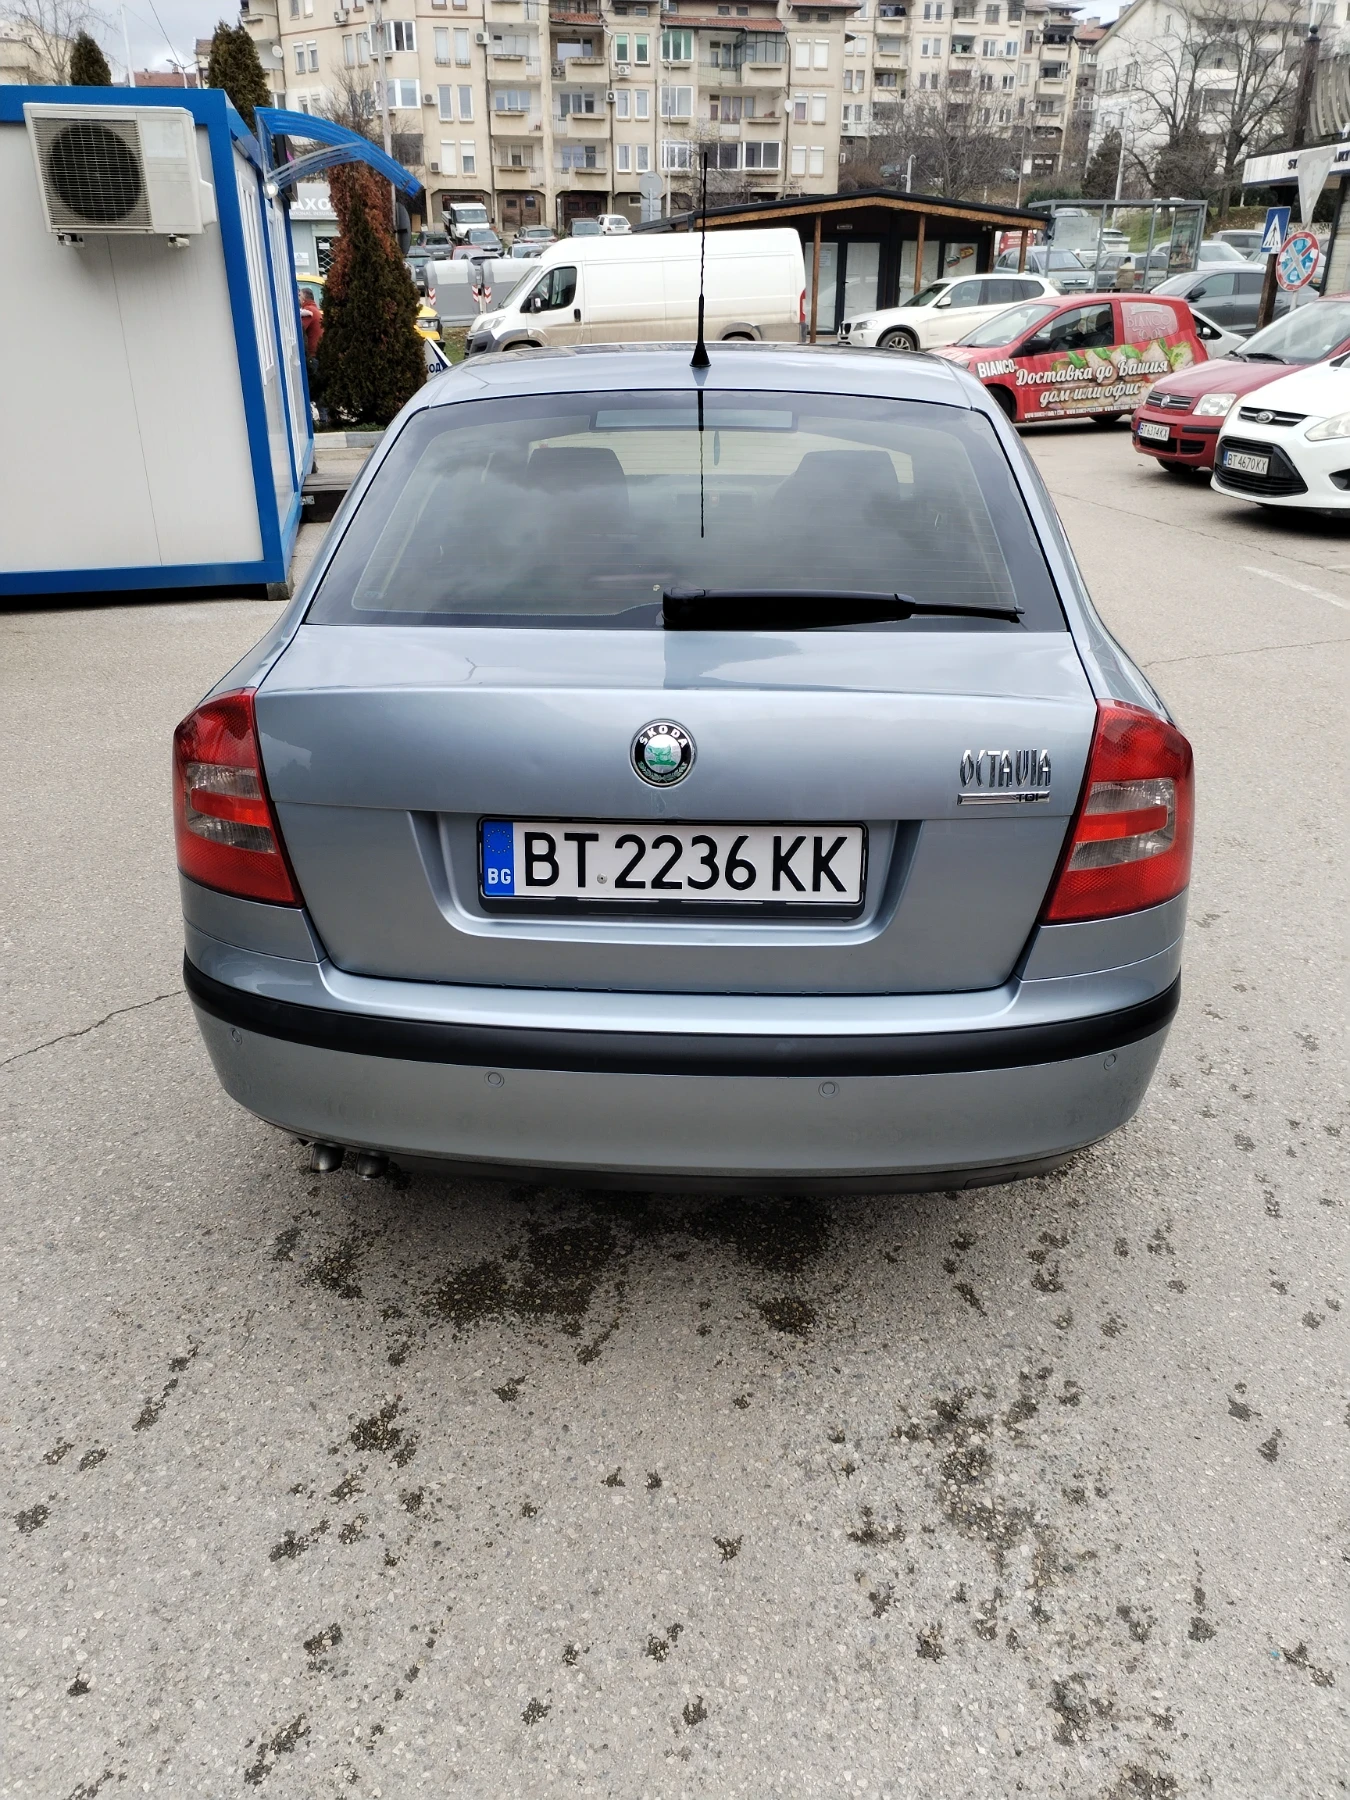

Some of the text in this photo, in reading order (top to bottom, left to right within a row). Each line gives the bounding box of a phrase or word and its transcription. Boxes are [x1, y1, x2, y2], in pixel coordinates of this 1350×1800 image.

[1126, 313, 1171, 329] BIANCO
[426, 362, 441, 374] ОД
[978, 359, 1015, 378] BIANCO
[1016, 360, 1168, 386] Доставка до Вашия
[1040, 380, 1140, 408] дом или офис
[959, 748, 1052, 788] OCTAVIA
[524, 831, 848, 893] BT 2236 KK
[486, 867, 512, 885] BG
